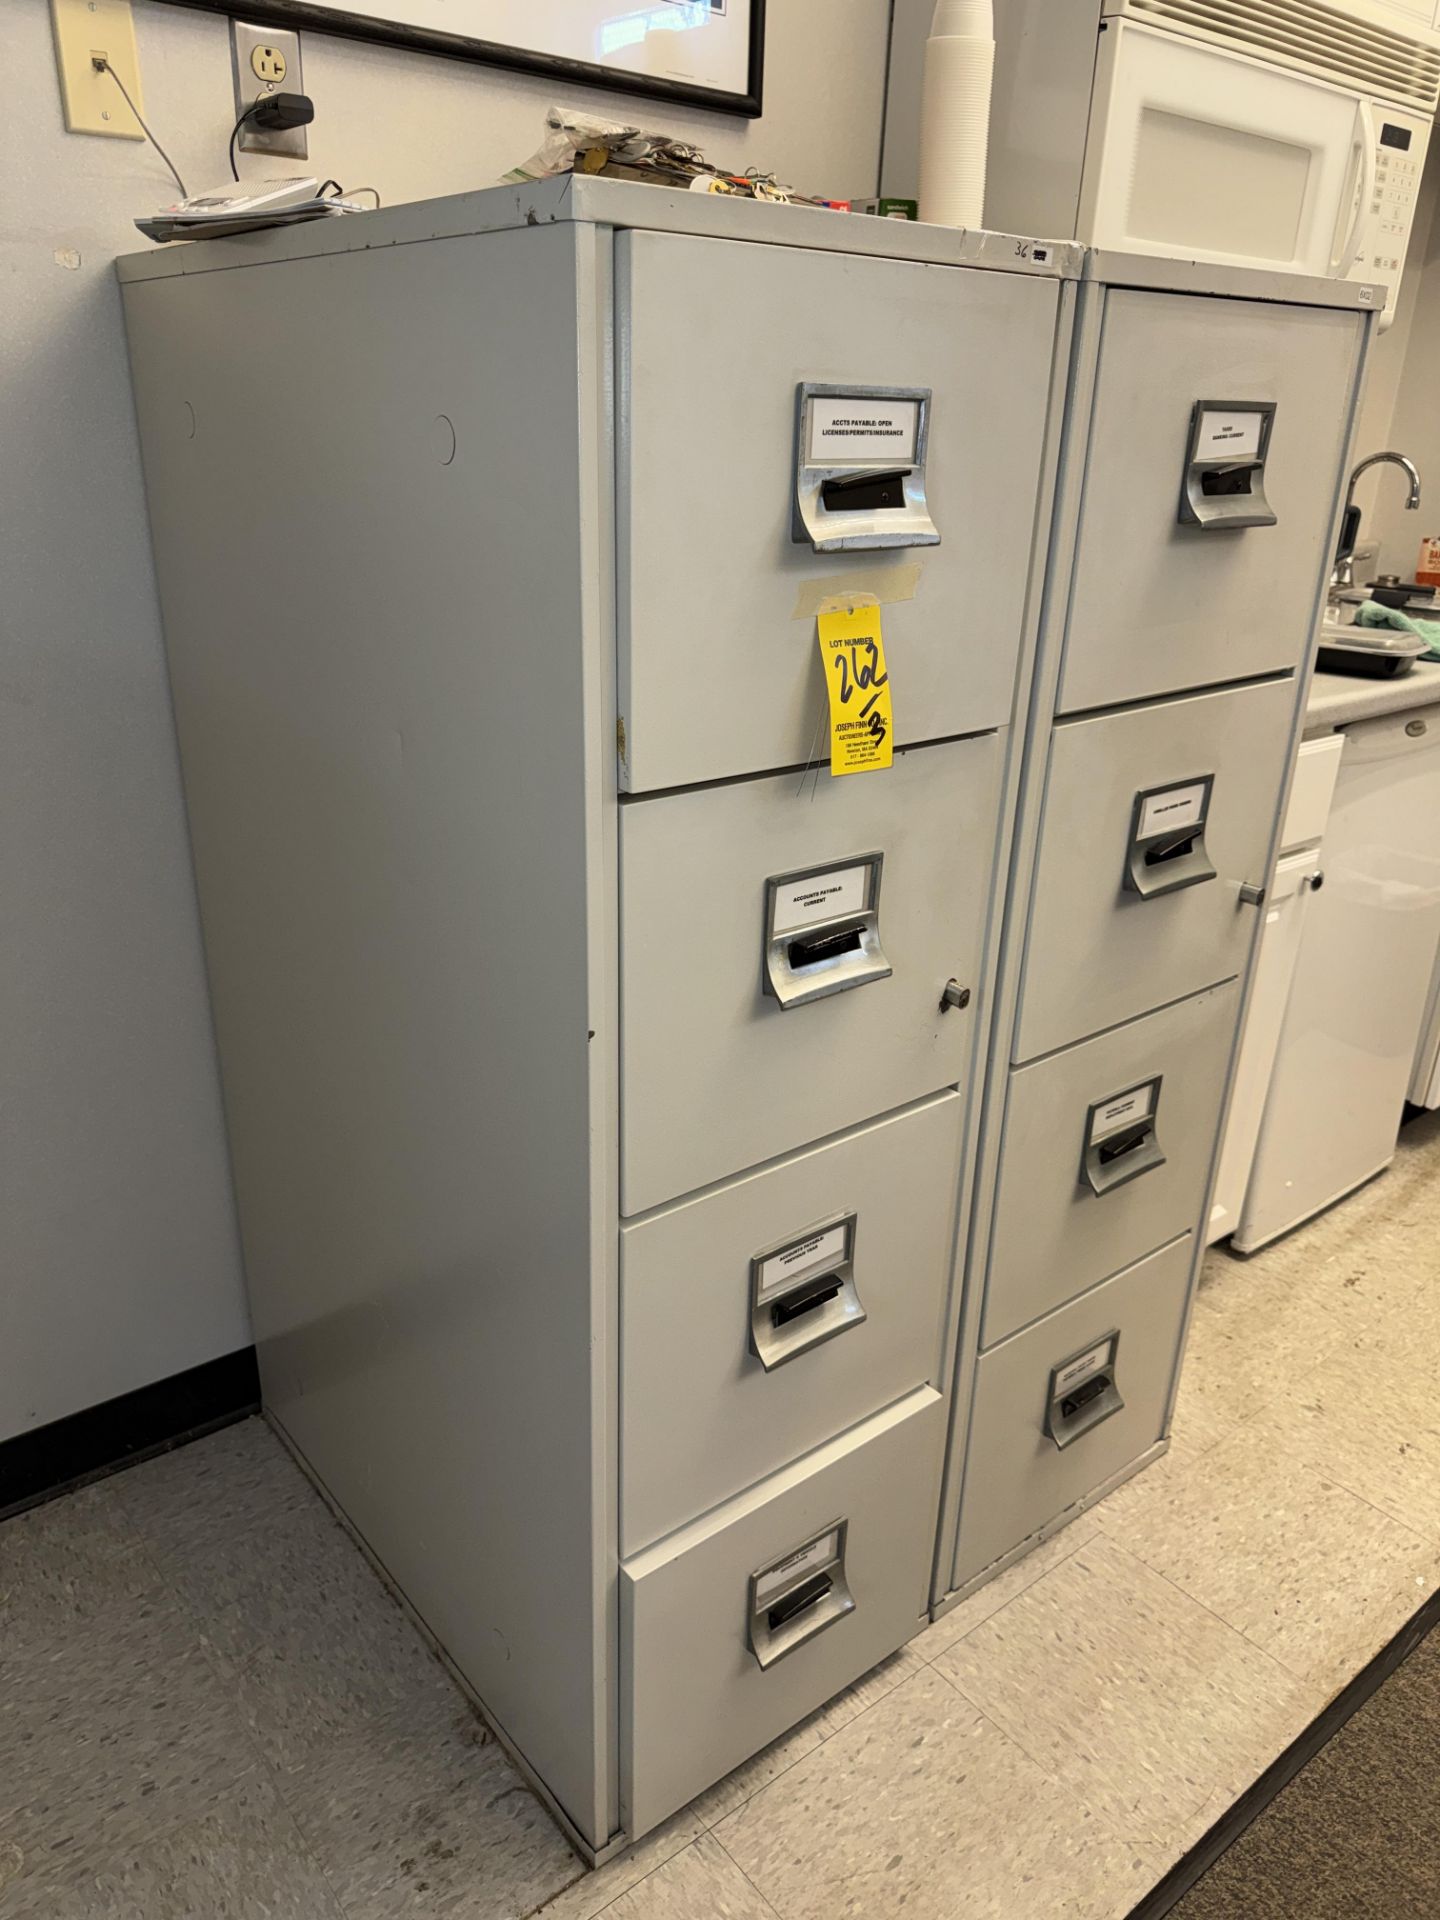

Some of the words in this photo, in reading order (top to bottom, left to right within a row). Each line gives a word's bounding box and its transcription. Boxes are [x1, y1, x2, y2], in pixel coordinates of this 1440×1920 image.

[1014, 240, 1029, 258] 36
[829, 639, 843, 648] LOT
[844, 637, 874, 646] NUMBER
[835, 645, 888, 703] 262
[835, 722, 855, 732] JOSEPH
[855, 720, 868, 730] FINN
[793, 892, 819, 902] ACCOUNTS
[804, 897, 826, 907] CURRENT
